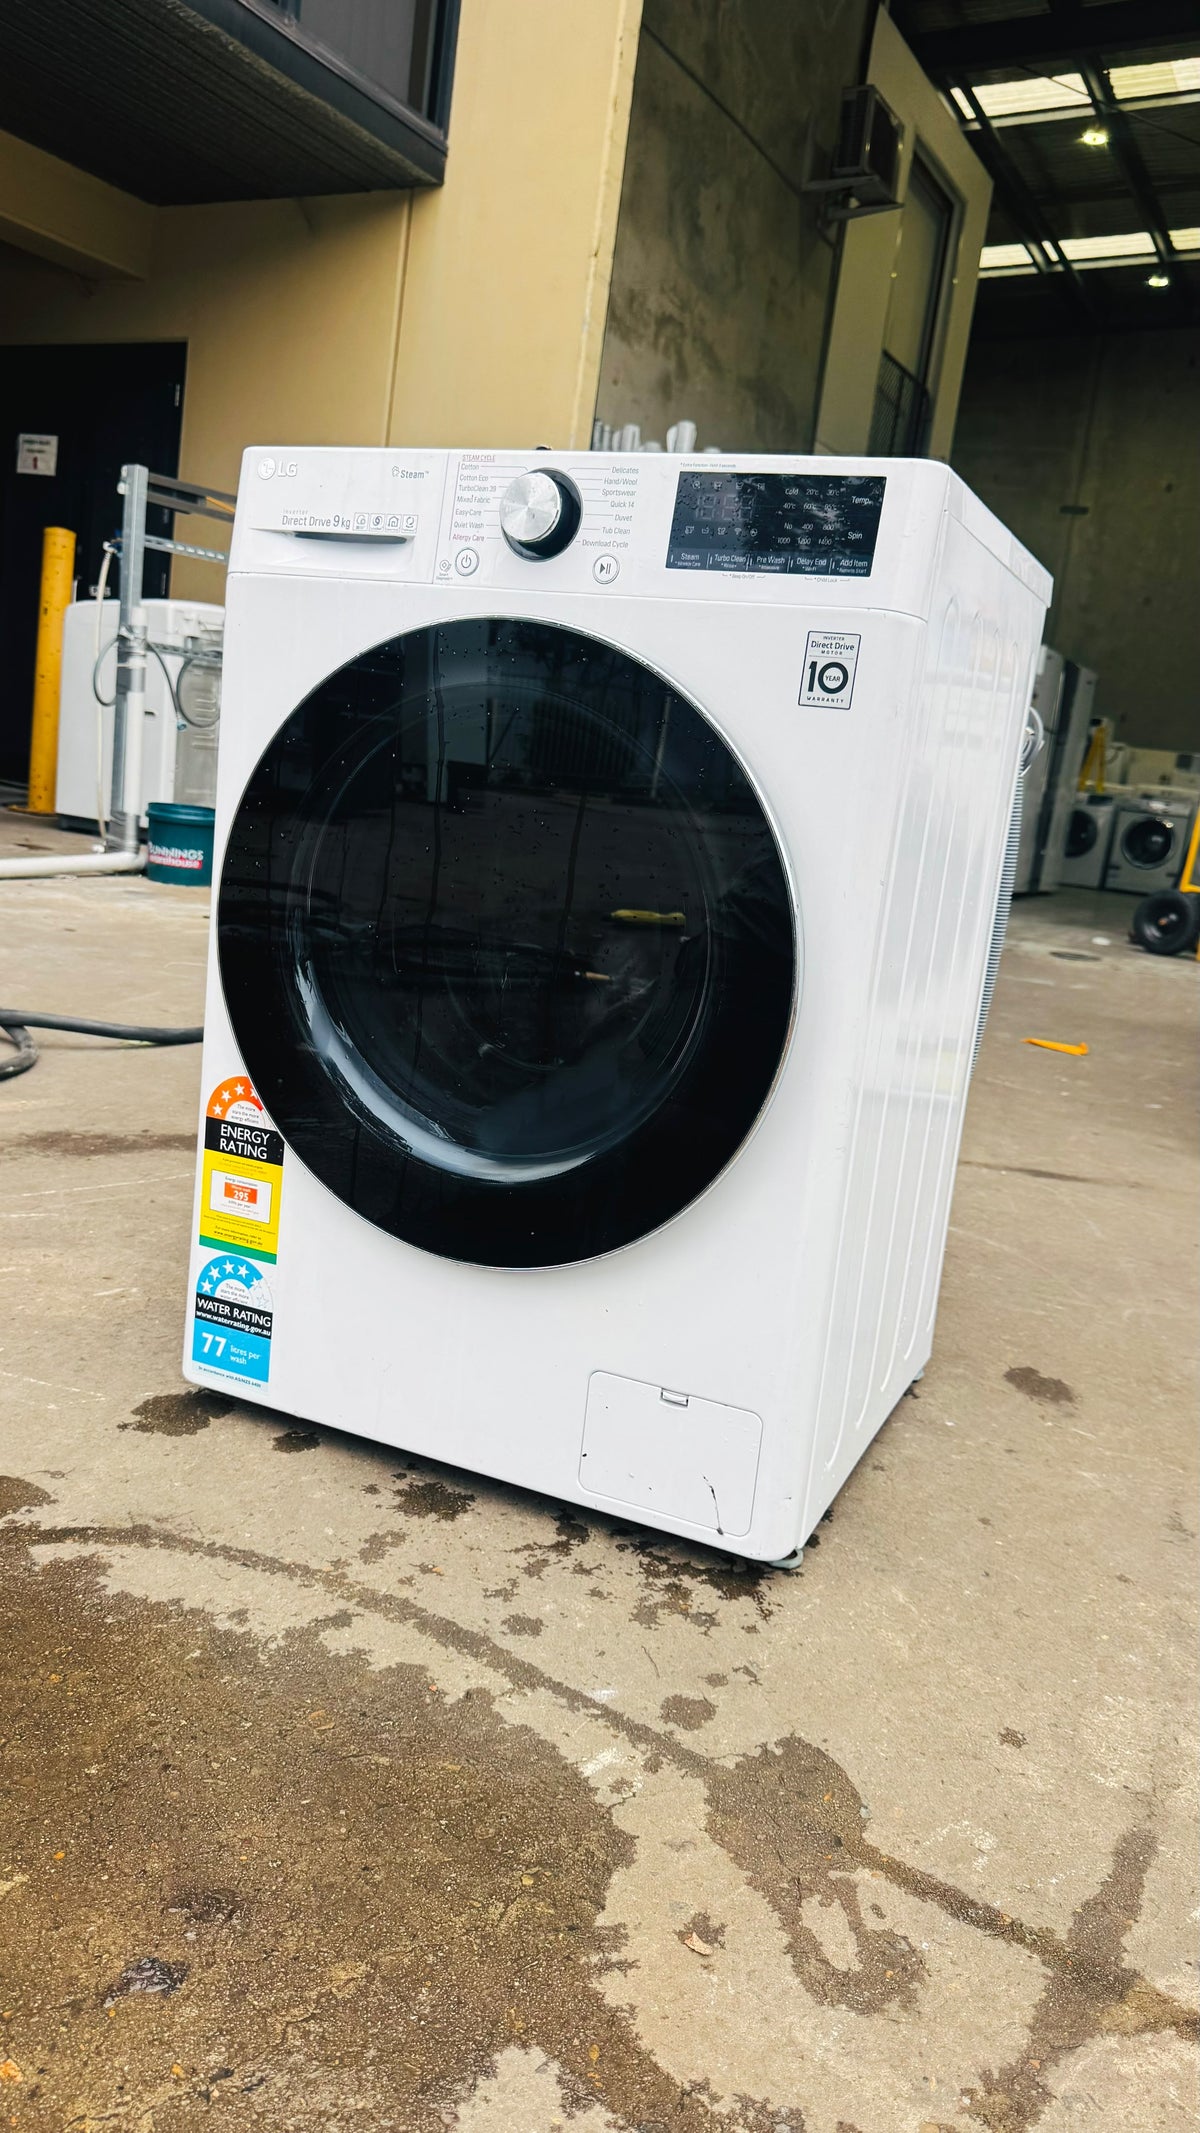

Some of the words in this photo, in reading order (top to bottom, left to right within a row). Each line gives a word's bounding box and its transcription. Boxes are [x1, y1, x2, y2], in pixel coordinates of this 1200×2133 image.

[277, 459, 297, 478] LG
[602, 488, 636, 496] Sportswear
[282, 515, 307, 526] Direct
[309, 516, 330, 527] Drive
[452, 534, 471, 542] Allergy
[848, 531, 862, 540] Spin
[582, 539, 611, 548] Download
[612, 540, 628, 548] Cycle
[680, 552, 700, 560] Steam
[714, 554, 730, 562] Turbo
[756, 556, 766, 564] Pre
[768, 556, 785, 564] Wash
[796, 558, 813, 566] Delay
[810, 640, 832, 650] Direct
[834, 642, 854, 650] Drive
[808, 660, 848, 694] 10
[220, 1124, 270, 1144] ENERGY
[220, 1138, 268, 1160] RATING
[234, 1190, 248, 1202] 295
[198, 1298, 230, 1316] WATER
[233, 1308, 272, 1327] RATING
[196, 1310, 271, 1336] www.waterrating.gov.au
[202, 1332, 226, 1357] 77
[230, 1344, 247, 1356] litres
[248, 1350, 260, 1360] per
[230, 1355, 246, 1365] wash
